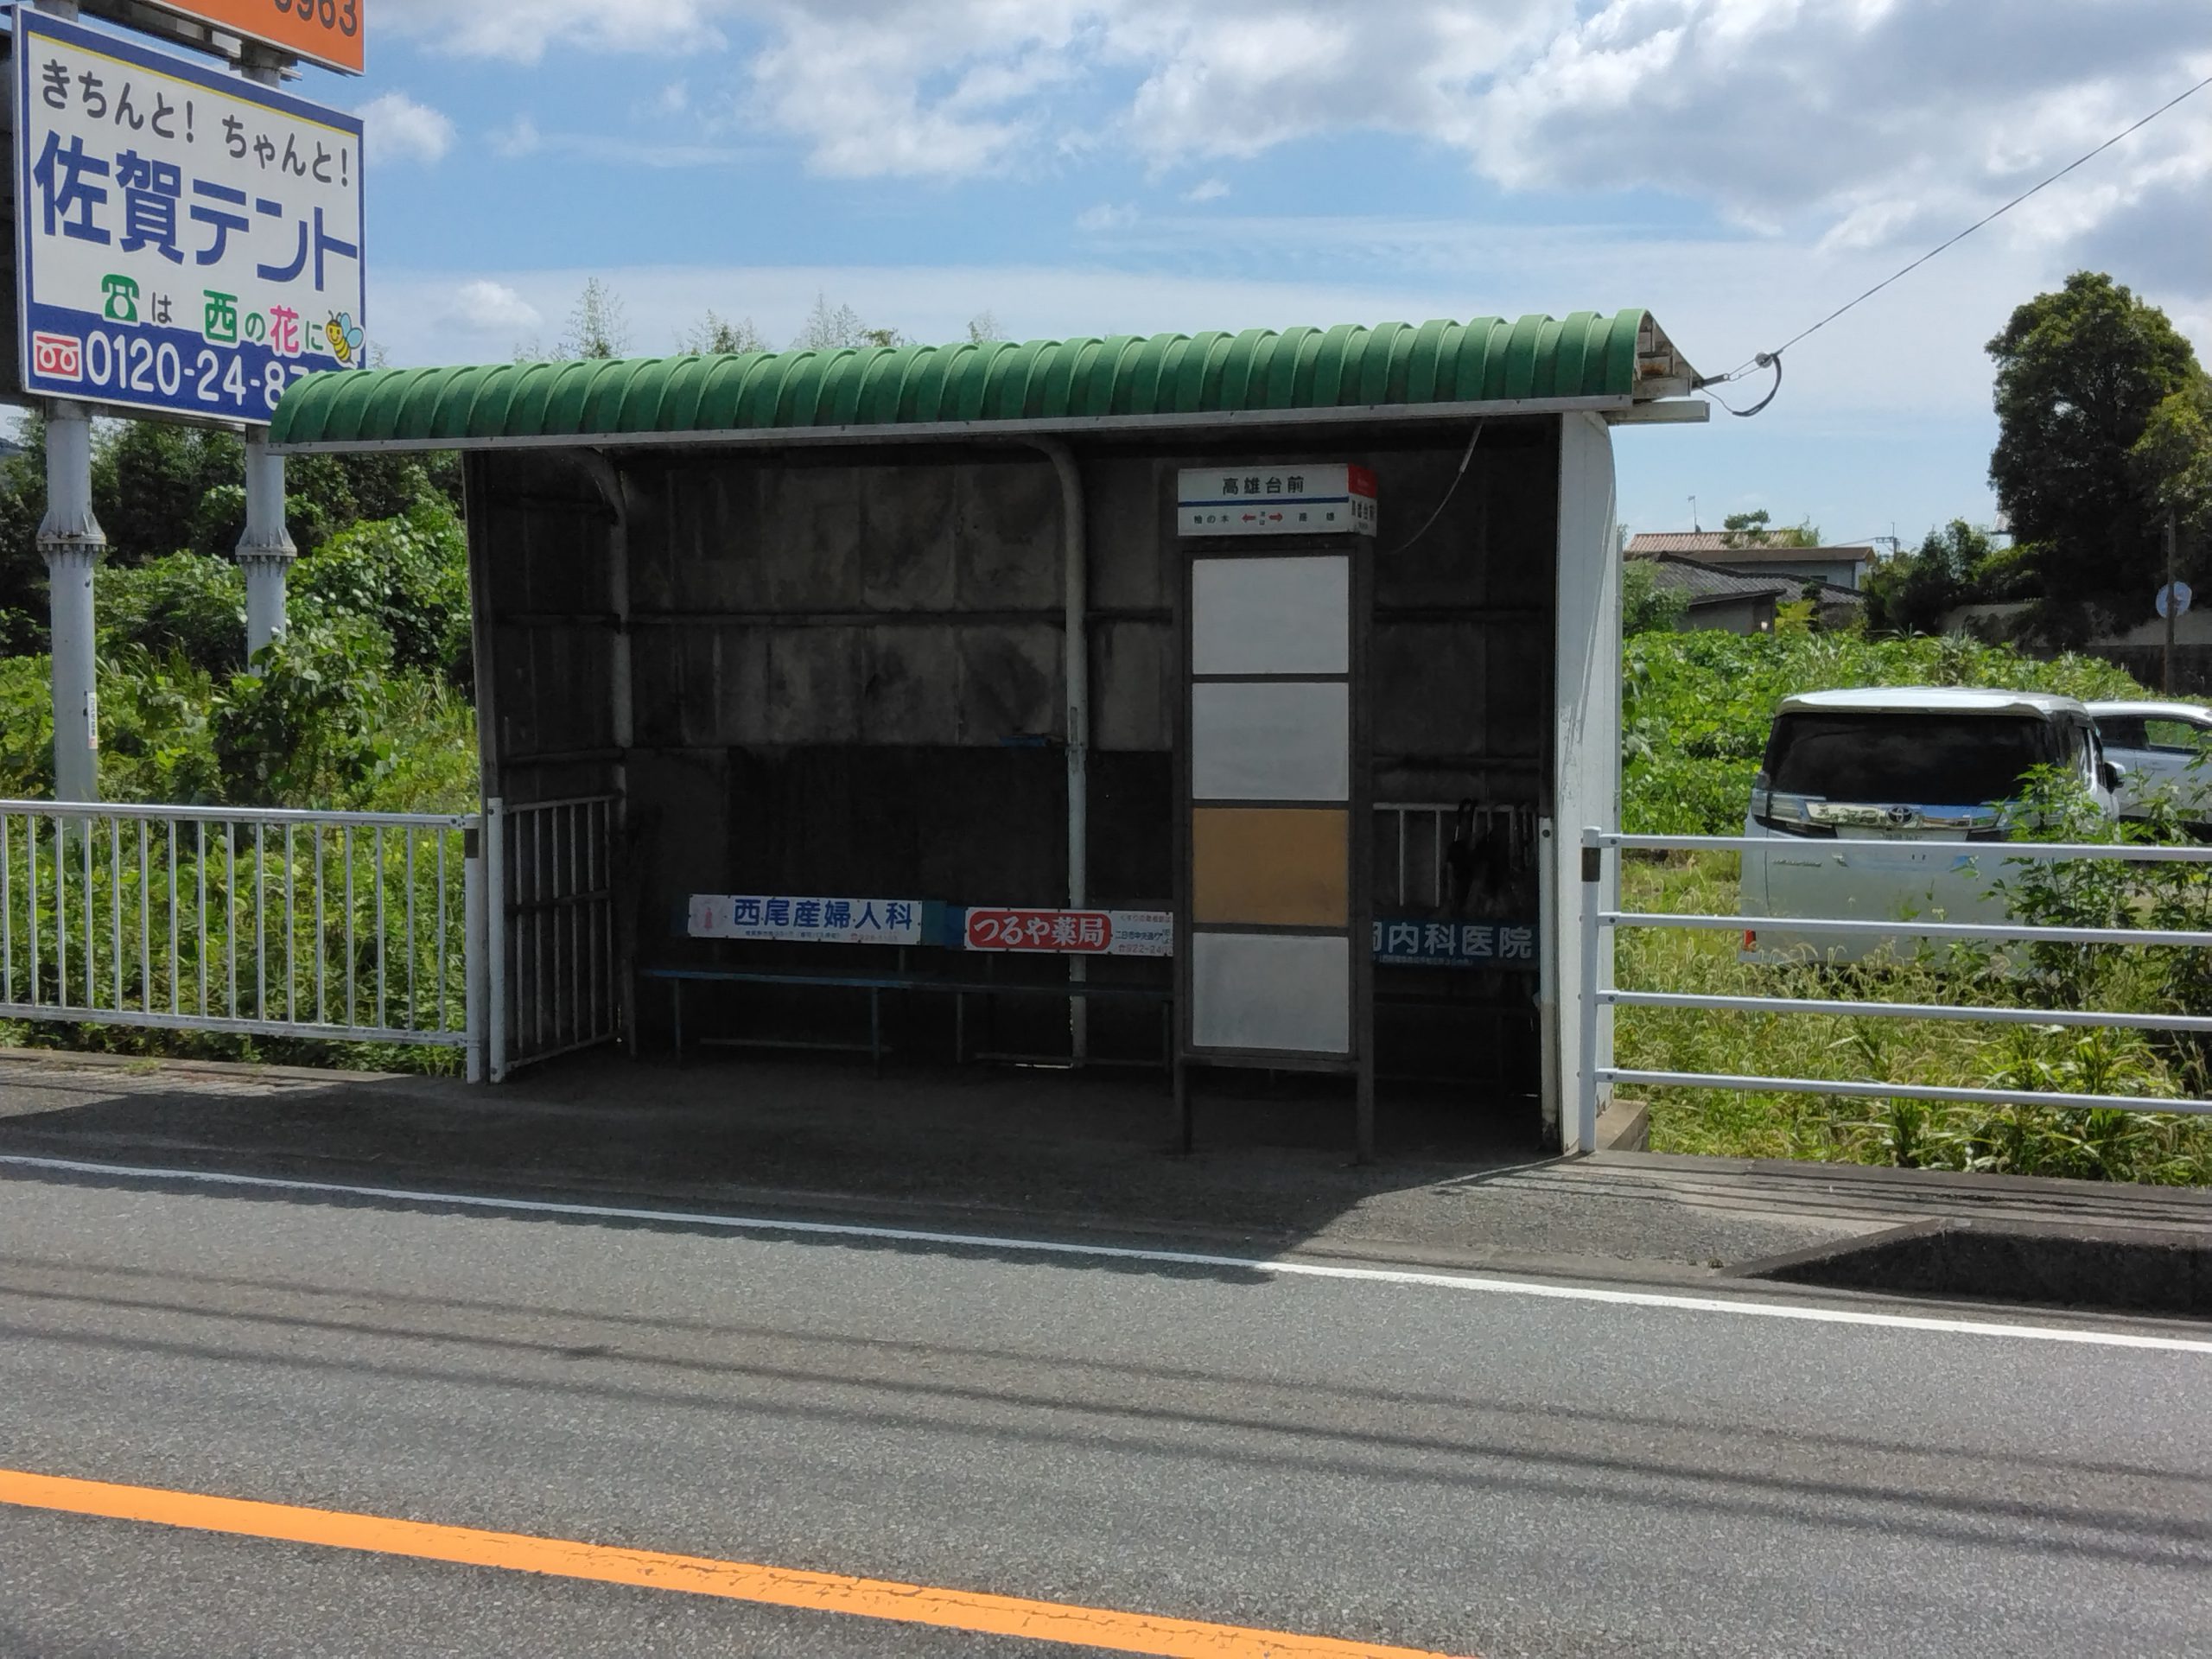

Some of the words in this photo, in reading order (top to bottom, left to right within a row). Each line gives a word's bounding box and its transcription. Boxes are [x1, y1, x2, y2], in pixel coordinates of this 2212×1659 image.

[275, 0, 357, 36] 63
[42, 59, 194, 143] きちんと!
[222, 114, 349, 188] ちゃんと!
[33, 129, 359, 292] 佐賀テント
[203, 289, 324, 354] 西の花に
[86, 331, 327, 411] 0120-24-8
[1223, 476, 1305, 496] 高雄台前
[734, 898, 912, 931] 西尾産婦人科
[974, 915, 1105, 947] つるや薬局
